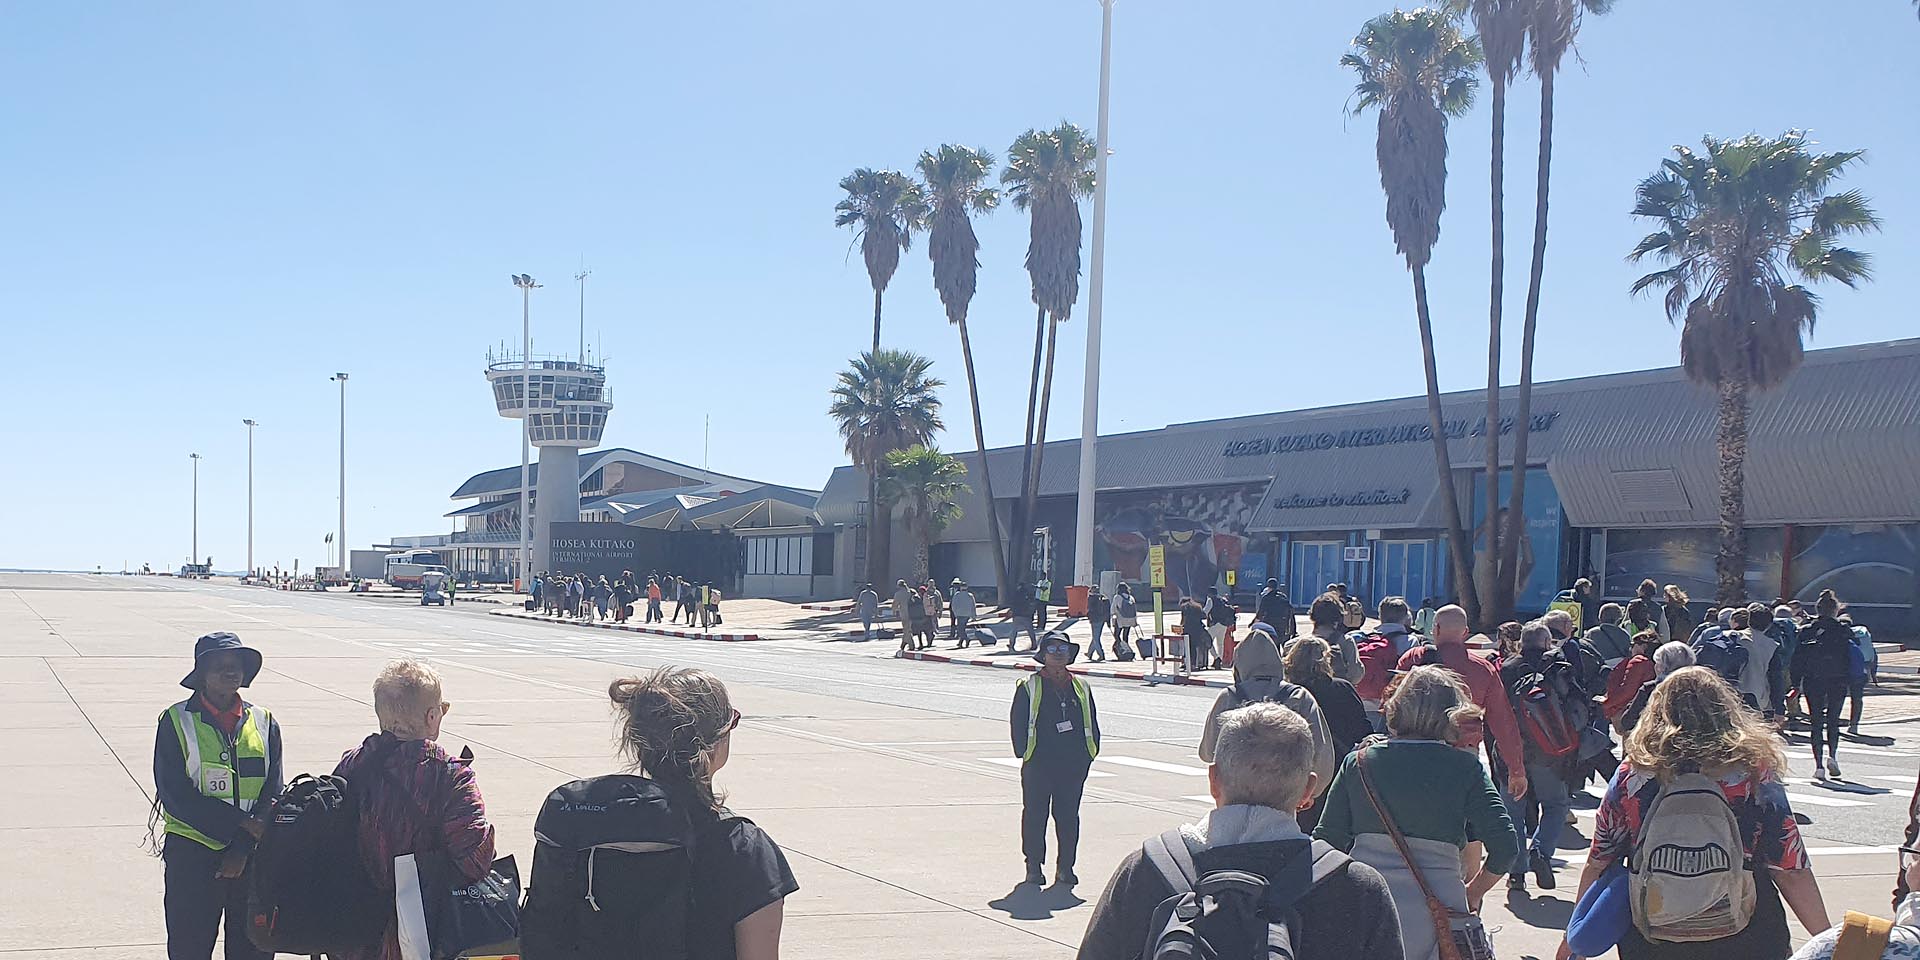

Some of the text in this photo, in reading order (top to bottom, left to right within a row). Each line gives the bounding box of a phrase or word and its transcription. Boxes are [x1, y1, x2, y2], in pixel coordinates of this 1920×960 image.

[1336, 417, 1468, 448] INTERNATIOAL
[552, 539, 636, 550] HOSEA KUTAKO
[552, 551, 633, 559] INTERNATIONAL AIRPORT
[209, 780, 227, 792] 30
